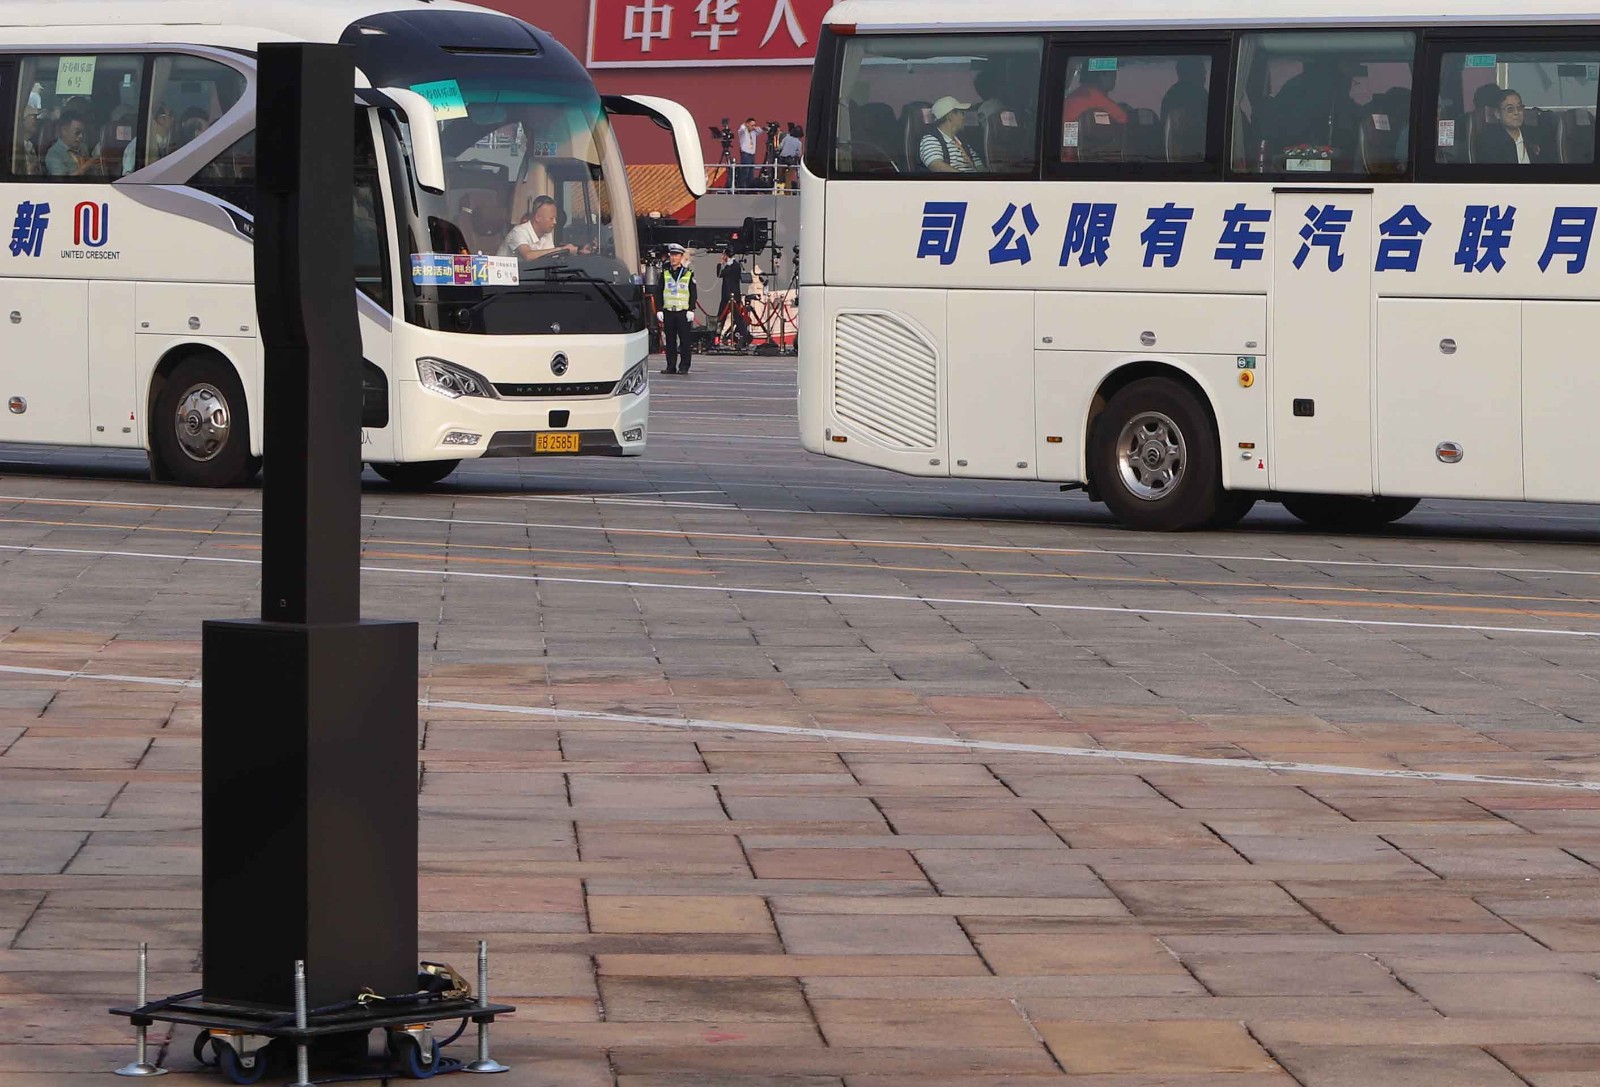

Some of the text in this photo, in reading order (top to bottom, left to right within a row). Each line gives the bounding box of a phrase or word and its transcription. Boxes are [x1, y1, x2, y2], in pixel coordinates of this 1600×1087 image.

[9, 201, 51, 258] 新
[61, 250, 120, 260] UNITED CRESCENT
